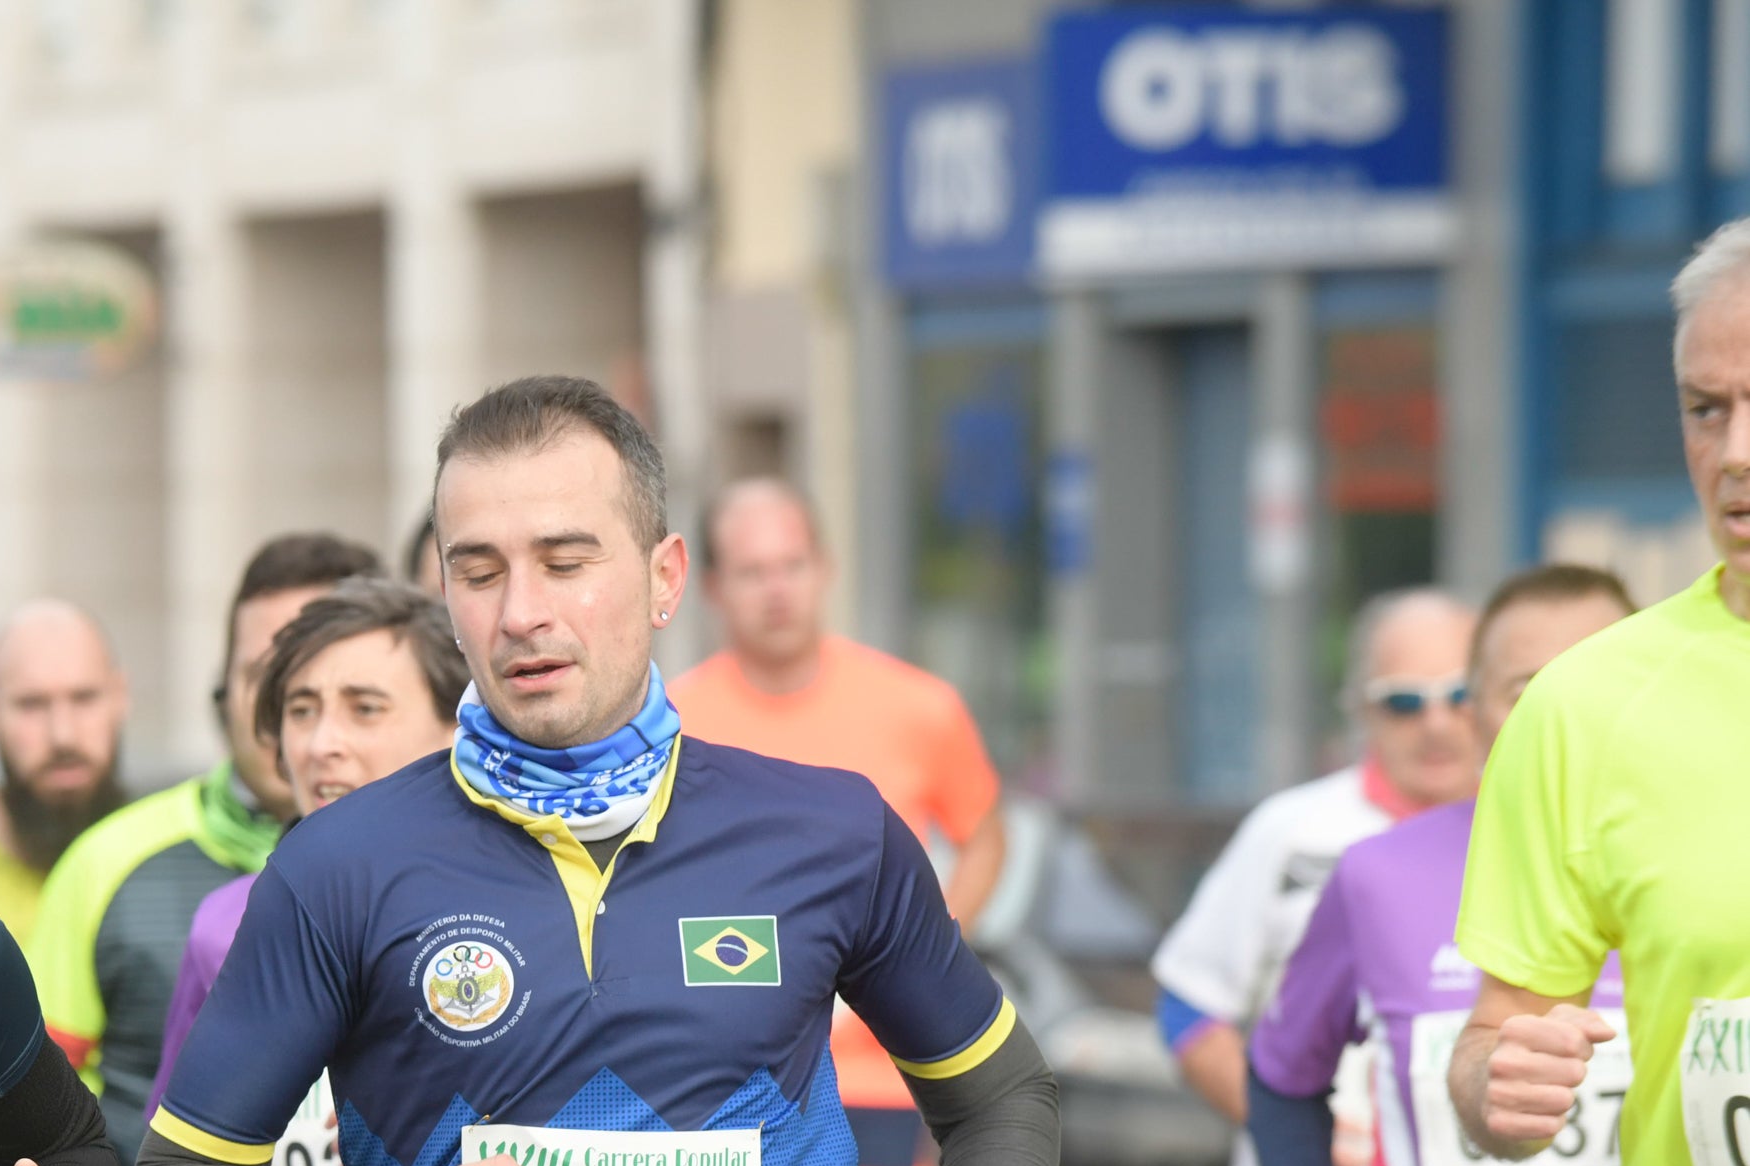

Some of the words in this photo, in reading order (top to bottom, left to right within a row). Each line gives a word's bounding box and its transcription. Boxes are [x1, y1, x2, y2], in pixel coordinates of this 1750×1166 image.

[1100, 24, 1404, 151] OTIS
[416, 915, 457, 942] MINISTÉRIO
[473, 914, 505, 928] DEFESA
[409, 934, 447, 987] DEPARTAMENTO
[448, 928, 458, 937] DE
[460, 928, 504, 942] DESPORTO
[503, 939, 526, 967] MILITAR
[440, 1033, 482, 1047] DESPORTIVA
[482, 1025, 510, 1044] MILITAR
[508, 1015, 519, 1027] DO
[516, 990, 532, 1017] BRASIL
